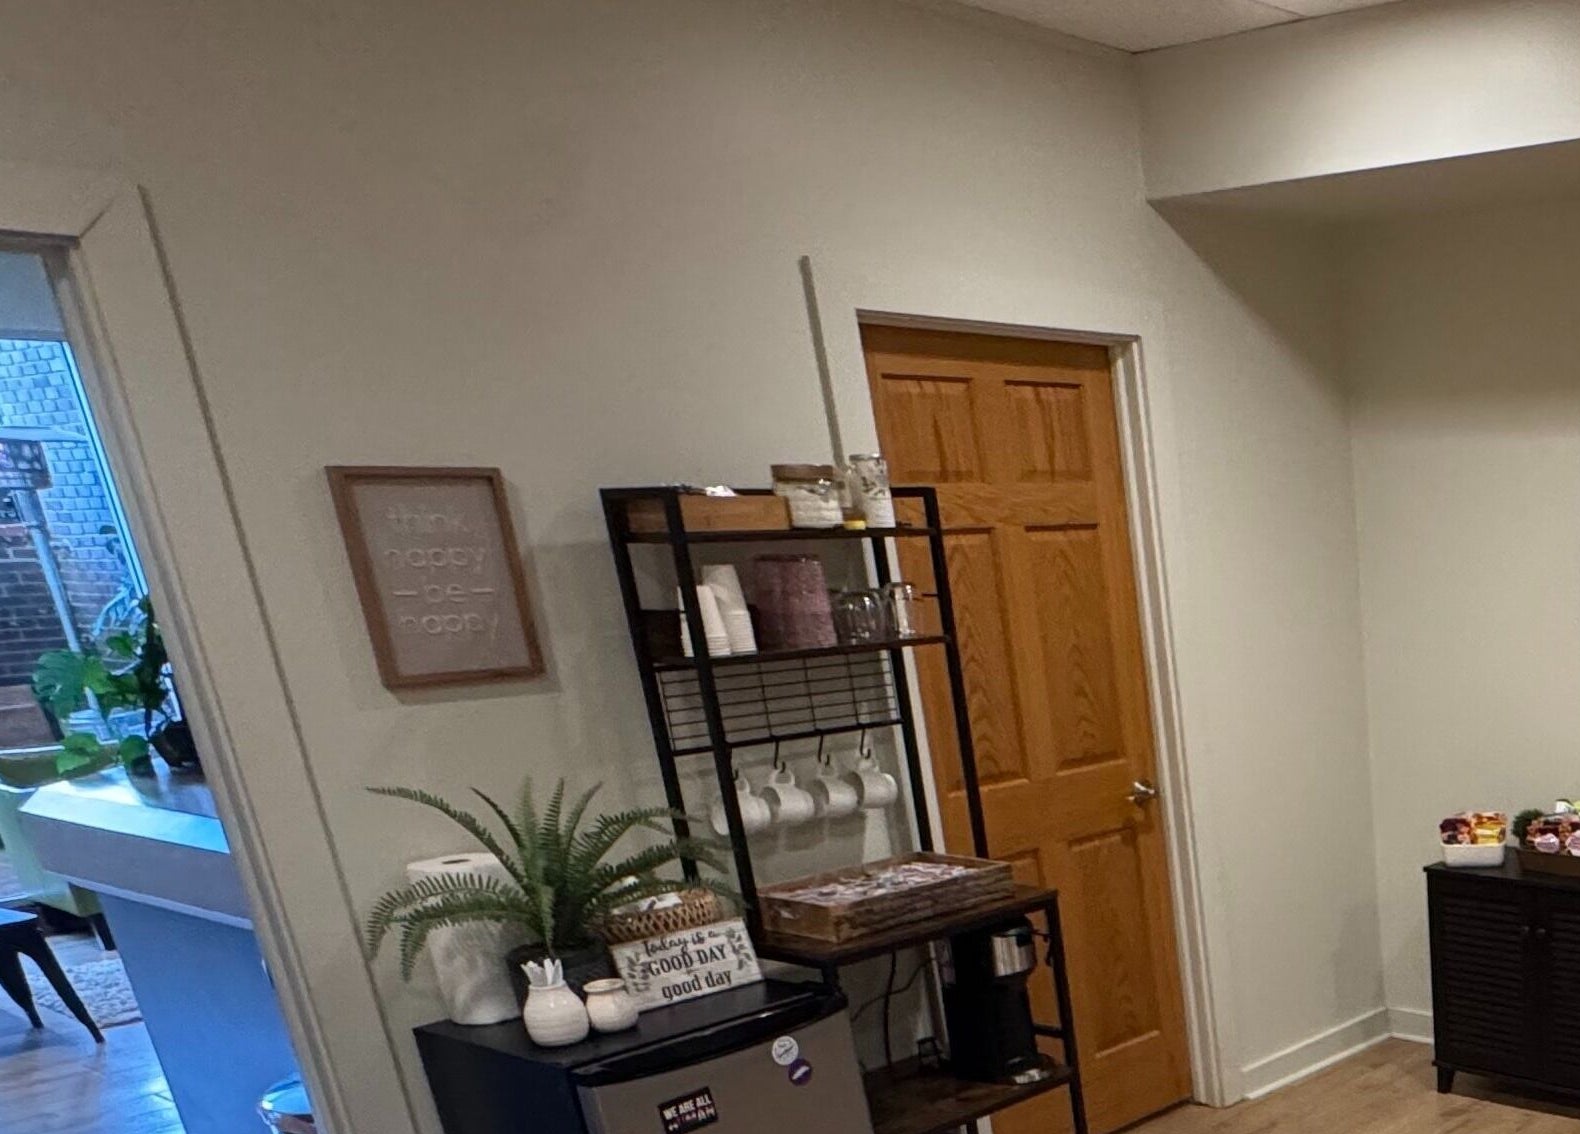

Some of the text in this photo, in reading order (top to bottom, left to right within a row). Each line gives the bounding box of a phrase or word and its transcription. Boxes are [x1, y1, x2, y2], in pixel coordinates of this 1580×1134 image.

[643, 937, 689, 957] Today
[649, 944, 727, 976] GOOD DAY
[662, 970, 733, 1000] good day
[663, 1106, 678, 1120] WE
[678, 1100, 697, 1115] ARE
[696, 1094, 712, 1108] ALL
